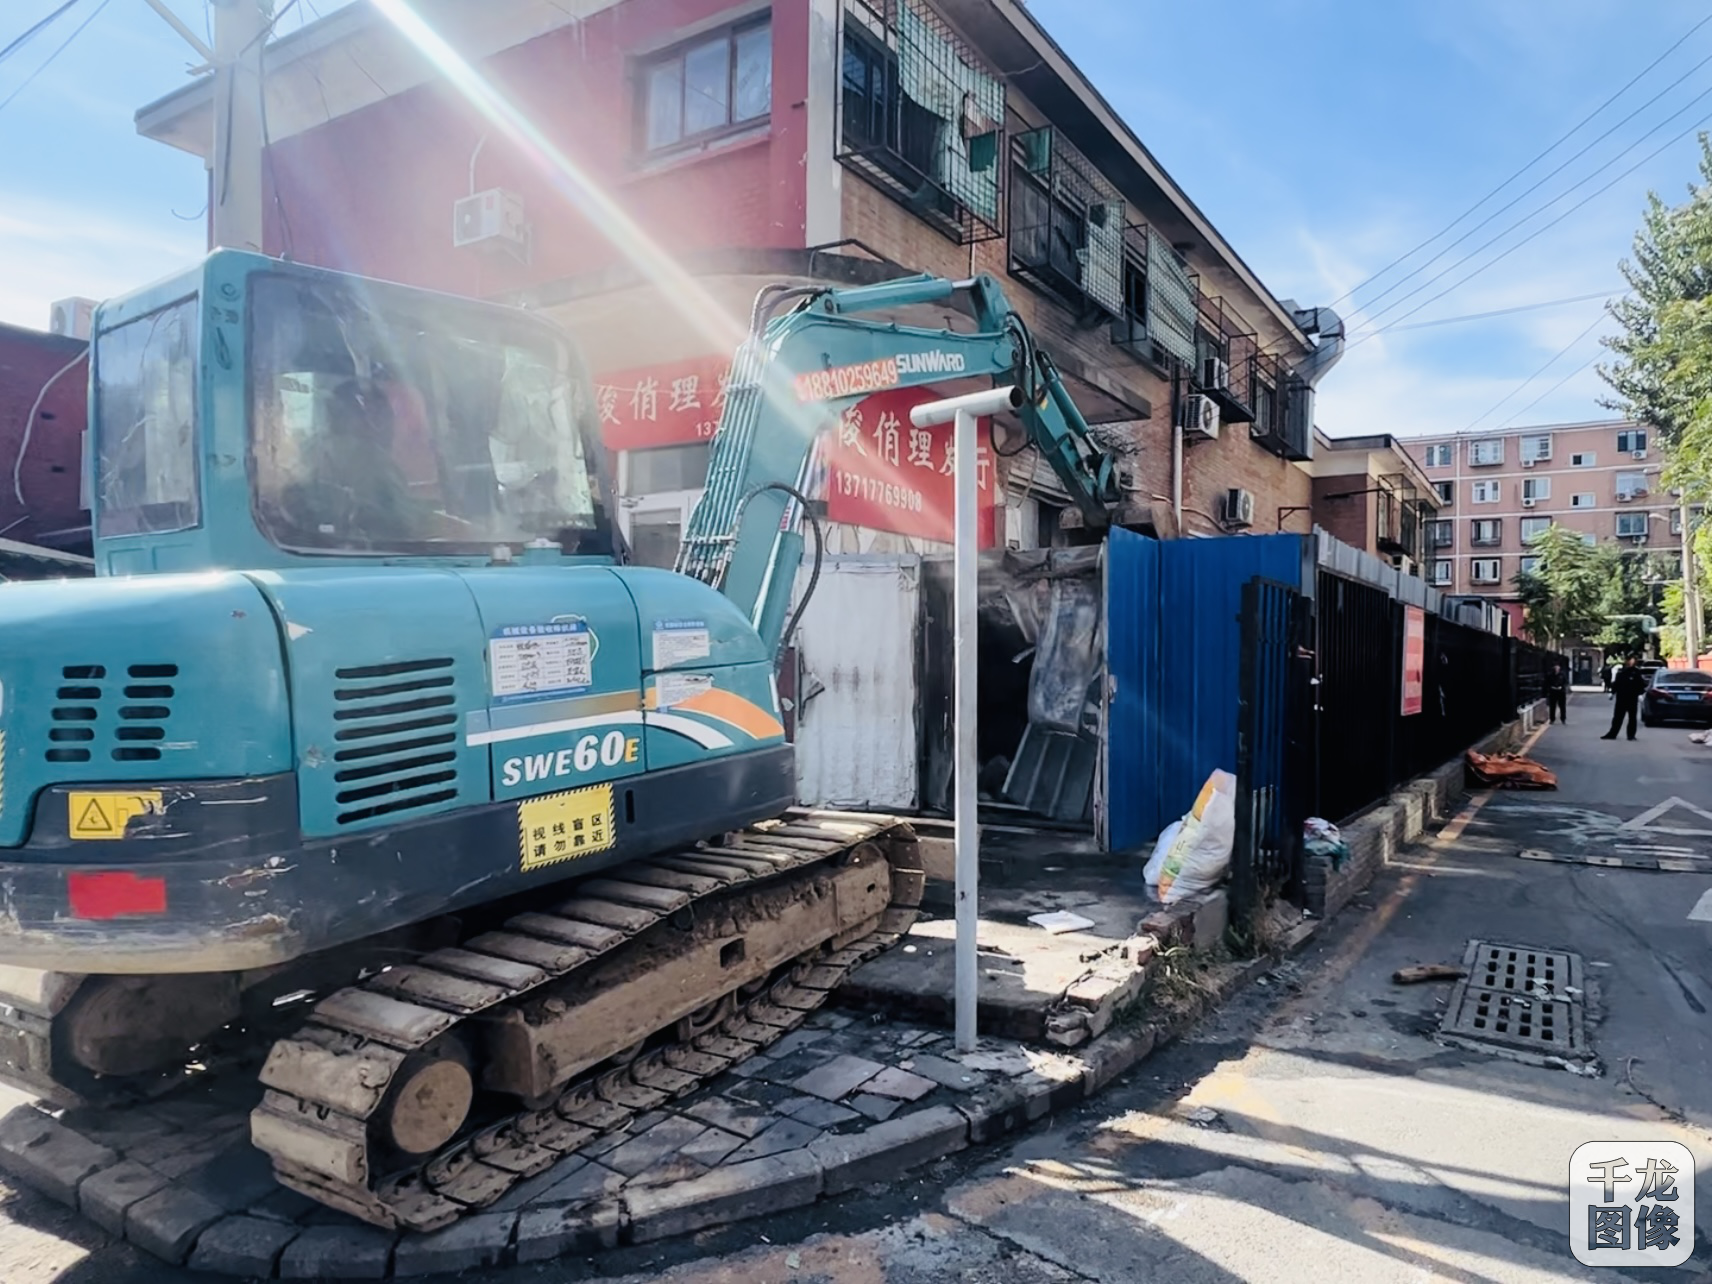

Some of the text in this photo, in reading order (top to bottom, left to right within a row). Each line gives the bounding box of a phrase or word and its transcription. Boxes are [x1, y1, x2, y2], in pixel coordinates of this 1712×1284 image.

[895, 349, 965, 373] SUNWARD
[835, 469, 922, 513] 13717769908
[501, 730, 640, 787] SWE60E
[533, 813, 602, 841] 视线盲区
[533, 829, 604, 858] 请勿靠近
